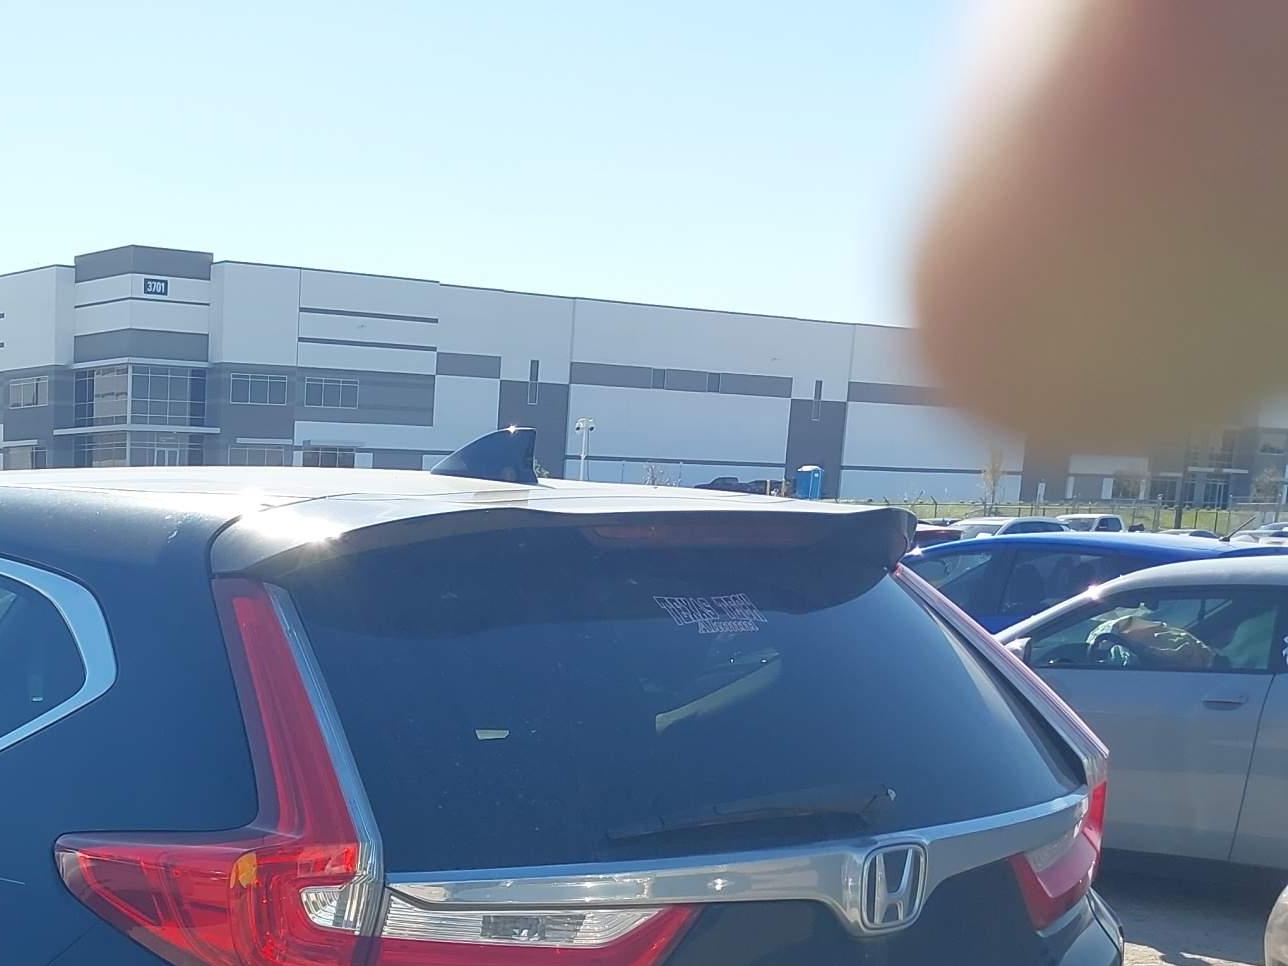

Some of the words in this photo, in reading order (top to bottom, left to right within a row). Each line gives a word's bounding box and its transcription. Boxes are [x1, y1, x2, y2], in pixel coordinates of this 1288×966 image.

[146, 281, 166, 294] 3701
[653, 595, 719, 626] TEXAS
[711, 592, 768, 623] TECH
